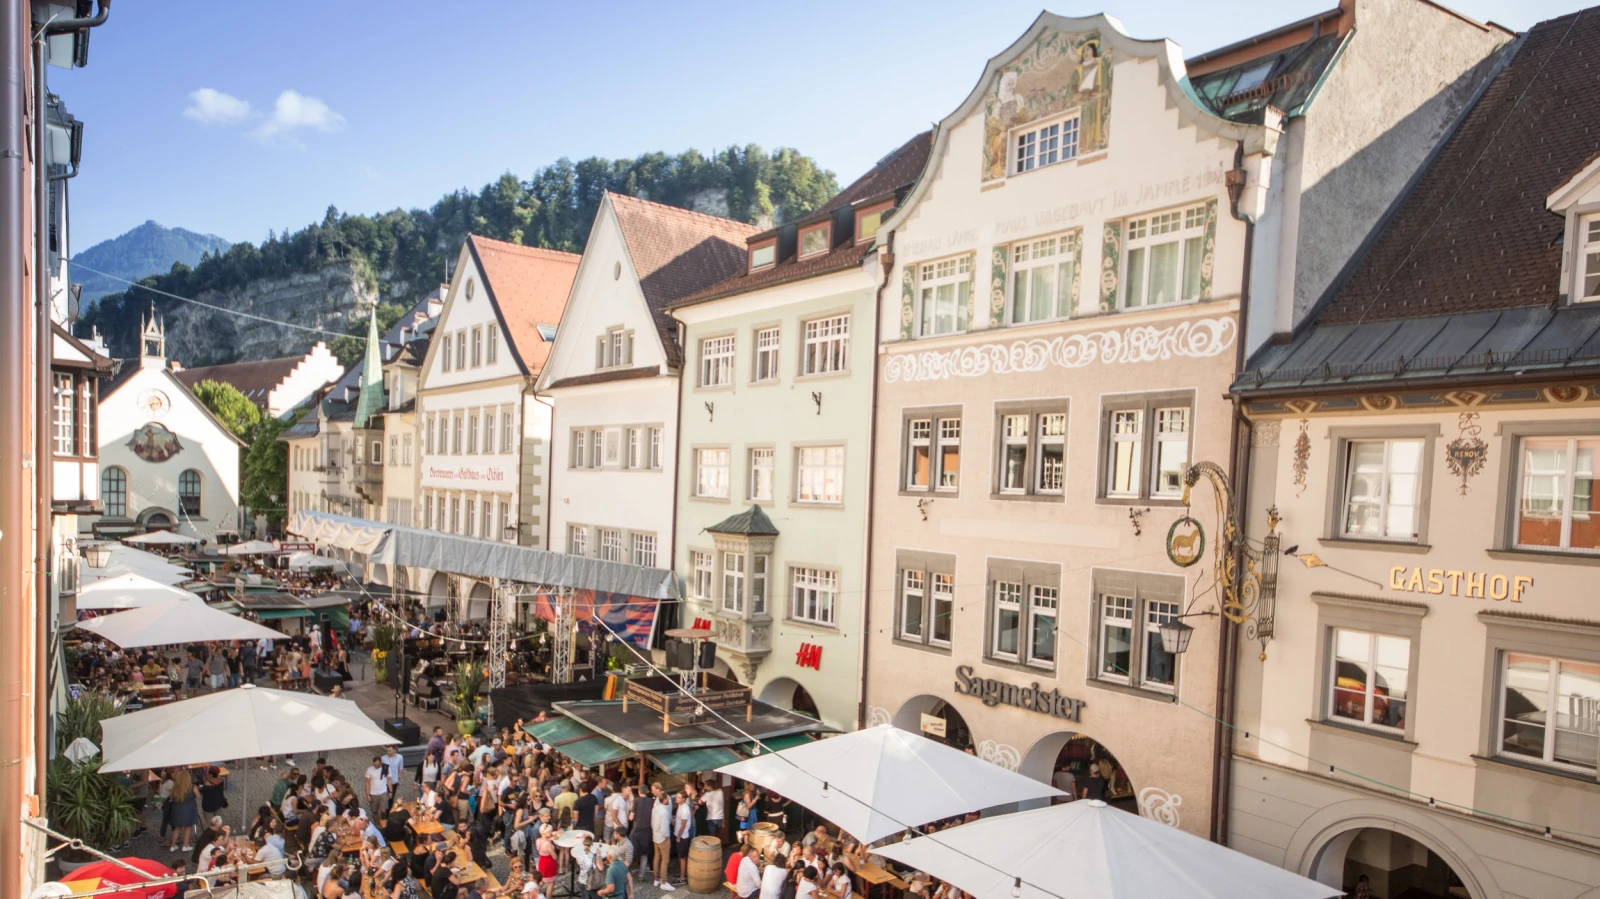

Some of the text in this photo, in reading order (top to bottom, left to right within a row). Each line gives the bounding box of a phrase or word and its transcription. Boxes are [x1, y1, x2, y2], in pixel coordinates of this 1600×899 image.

[1135, 178, 1190, 206] JAHRE
[1390, 566, 1534, 603] GASTHOF
[796, 642, 823, 671] H&M
[954, 664, 1086, 723] Sagmeister
